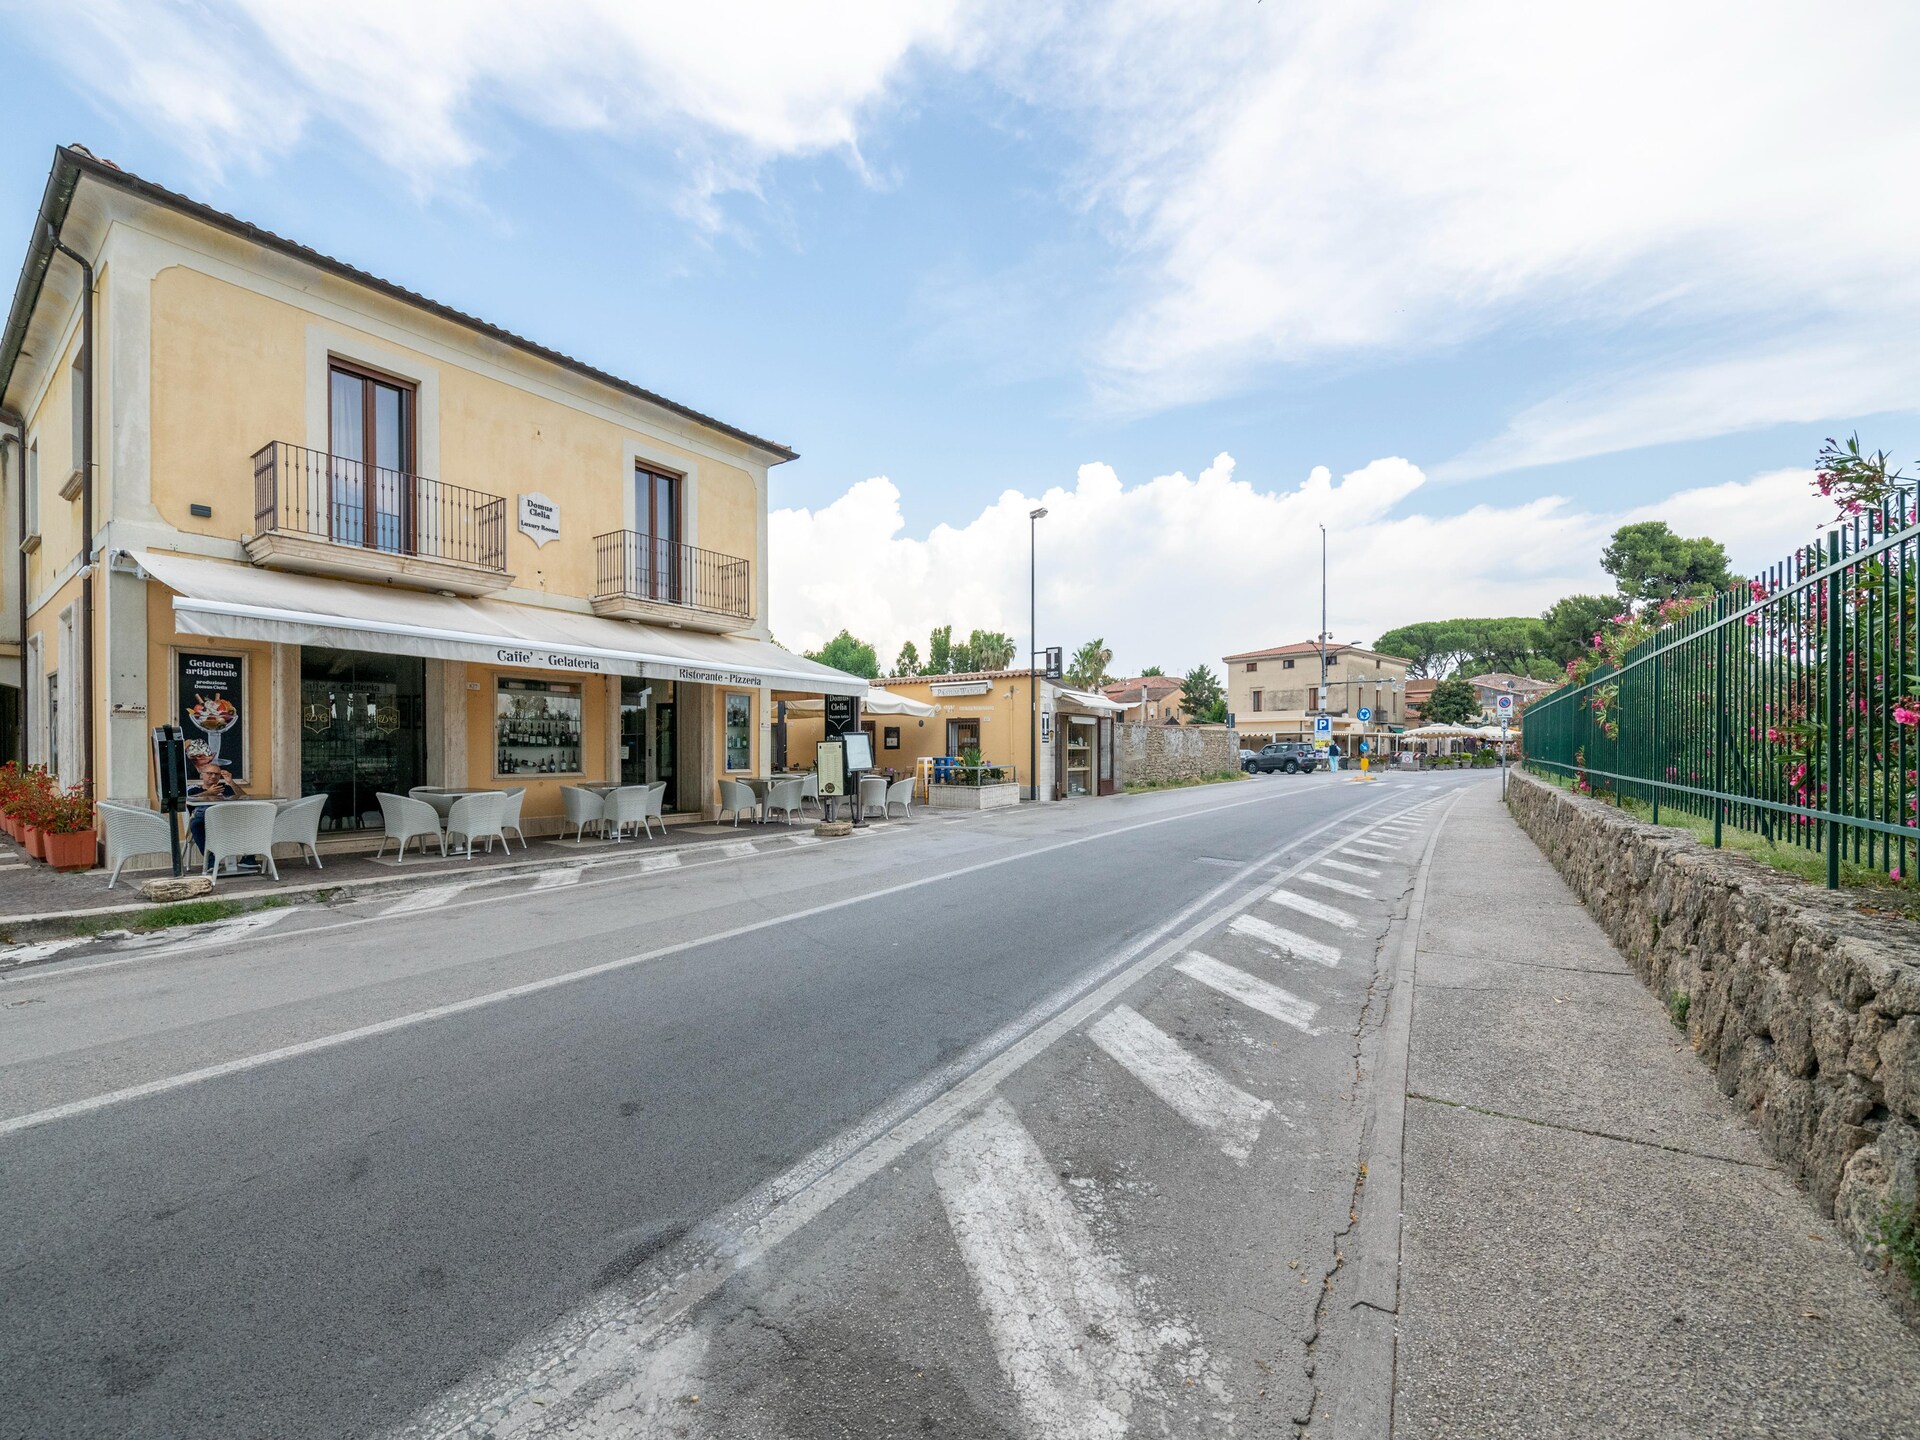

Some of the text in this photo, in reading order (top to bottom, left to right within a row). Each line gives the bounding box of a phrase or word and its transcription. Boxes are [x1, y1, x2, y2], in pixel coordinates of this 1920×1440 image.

[527, 499, 553, 512] Domus
[529, 508, 551, 520] Clelia
[520, 519, 559, 534] Luxury Rooms
[189, 659, 234, 669] Gelateria
[497, 649, 534, 664] Caffe'
[548, 654, 600, 670] Gelateria
[185, 667, 238, 678] artigianale
[679, 668, 723, 682] Ristorante
[729, 673, 762, 686] Pizzeria
[830, 702, 848, 711] Clelia
[1319, 719, 1328, 730] P
